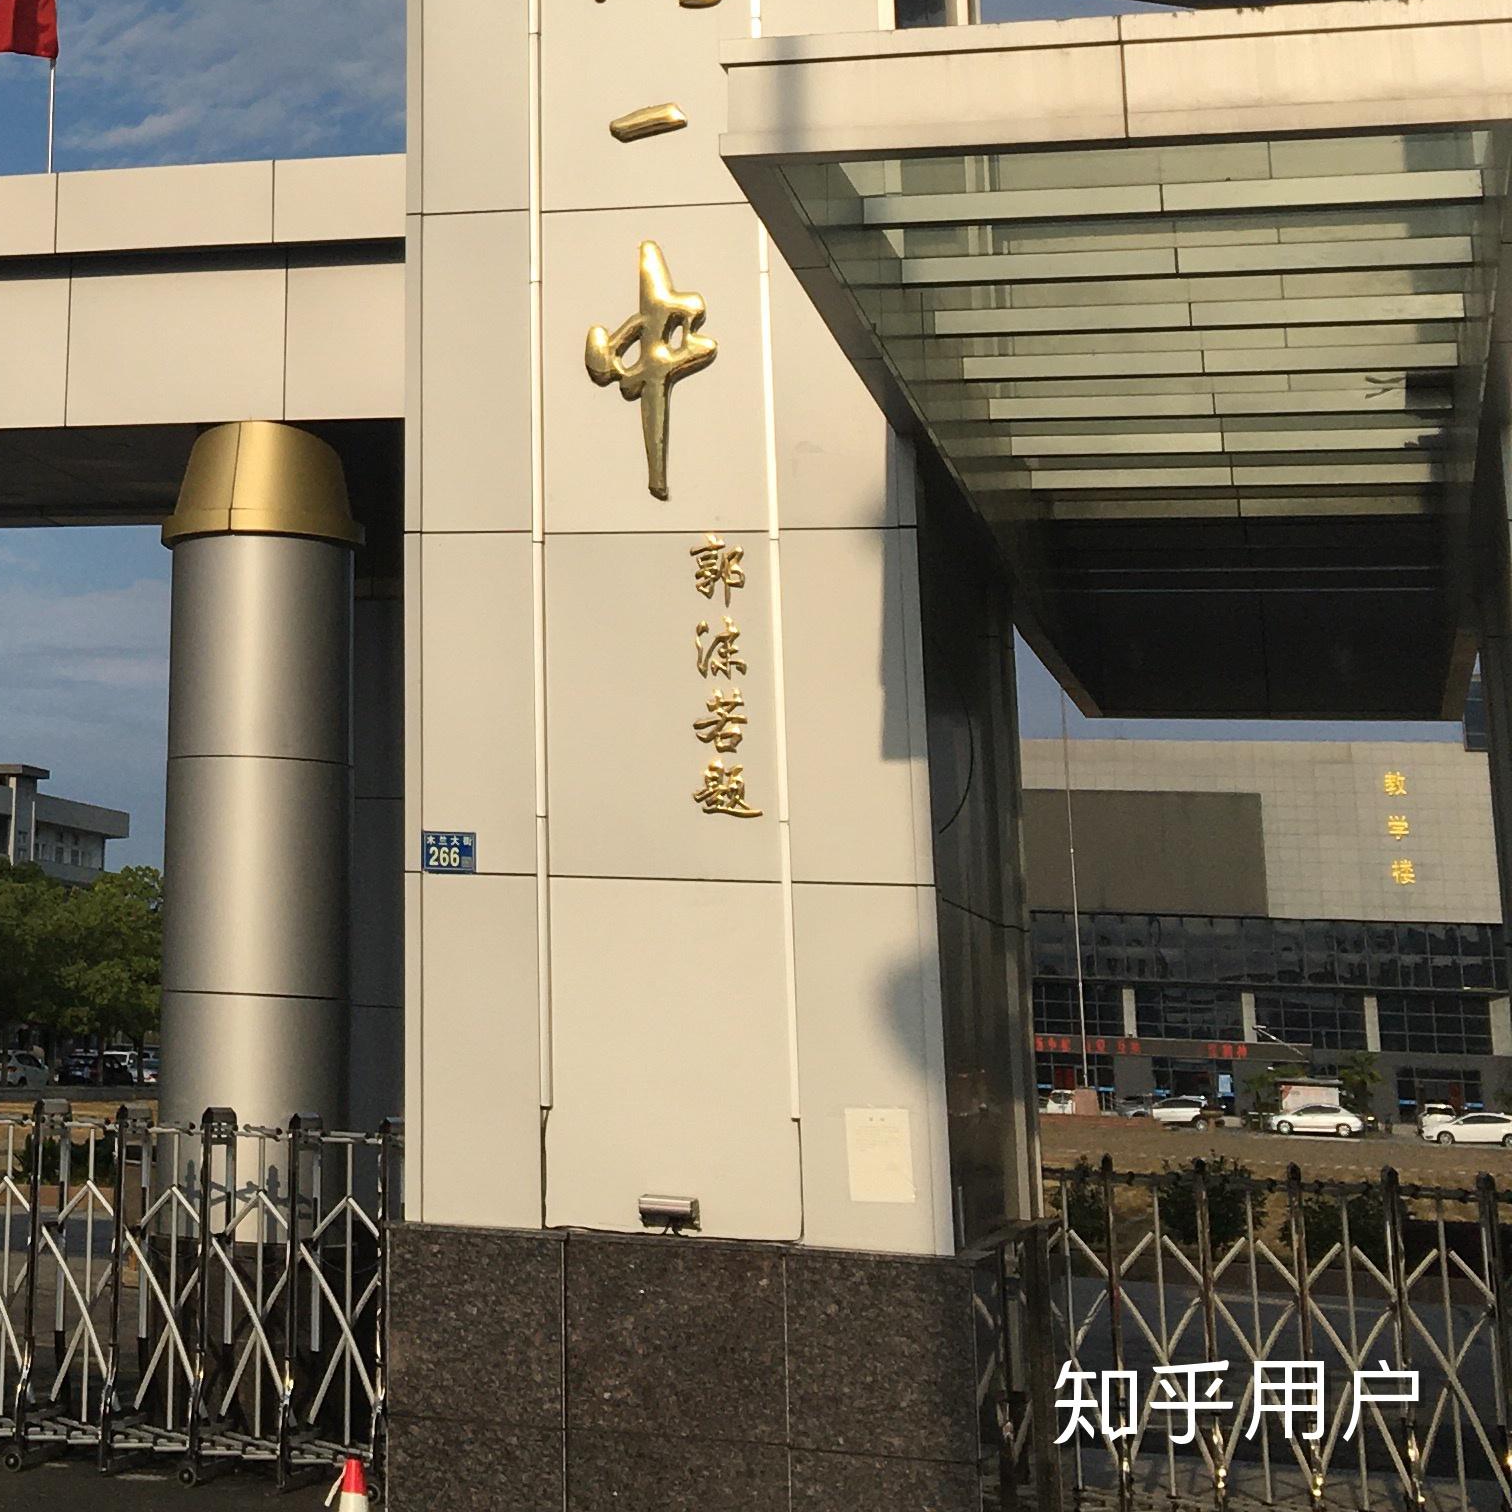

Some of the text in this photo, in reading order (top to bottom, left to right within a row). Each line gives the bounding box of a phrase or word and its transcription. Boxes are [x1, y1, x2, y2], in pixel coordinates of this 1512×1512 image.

[1384, 771, 1416, 885] 教学楼
[426, 835, 472, 846] 木兰大街
[429, 846, 460, 867] 266
